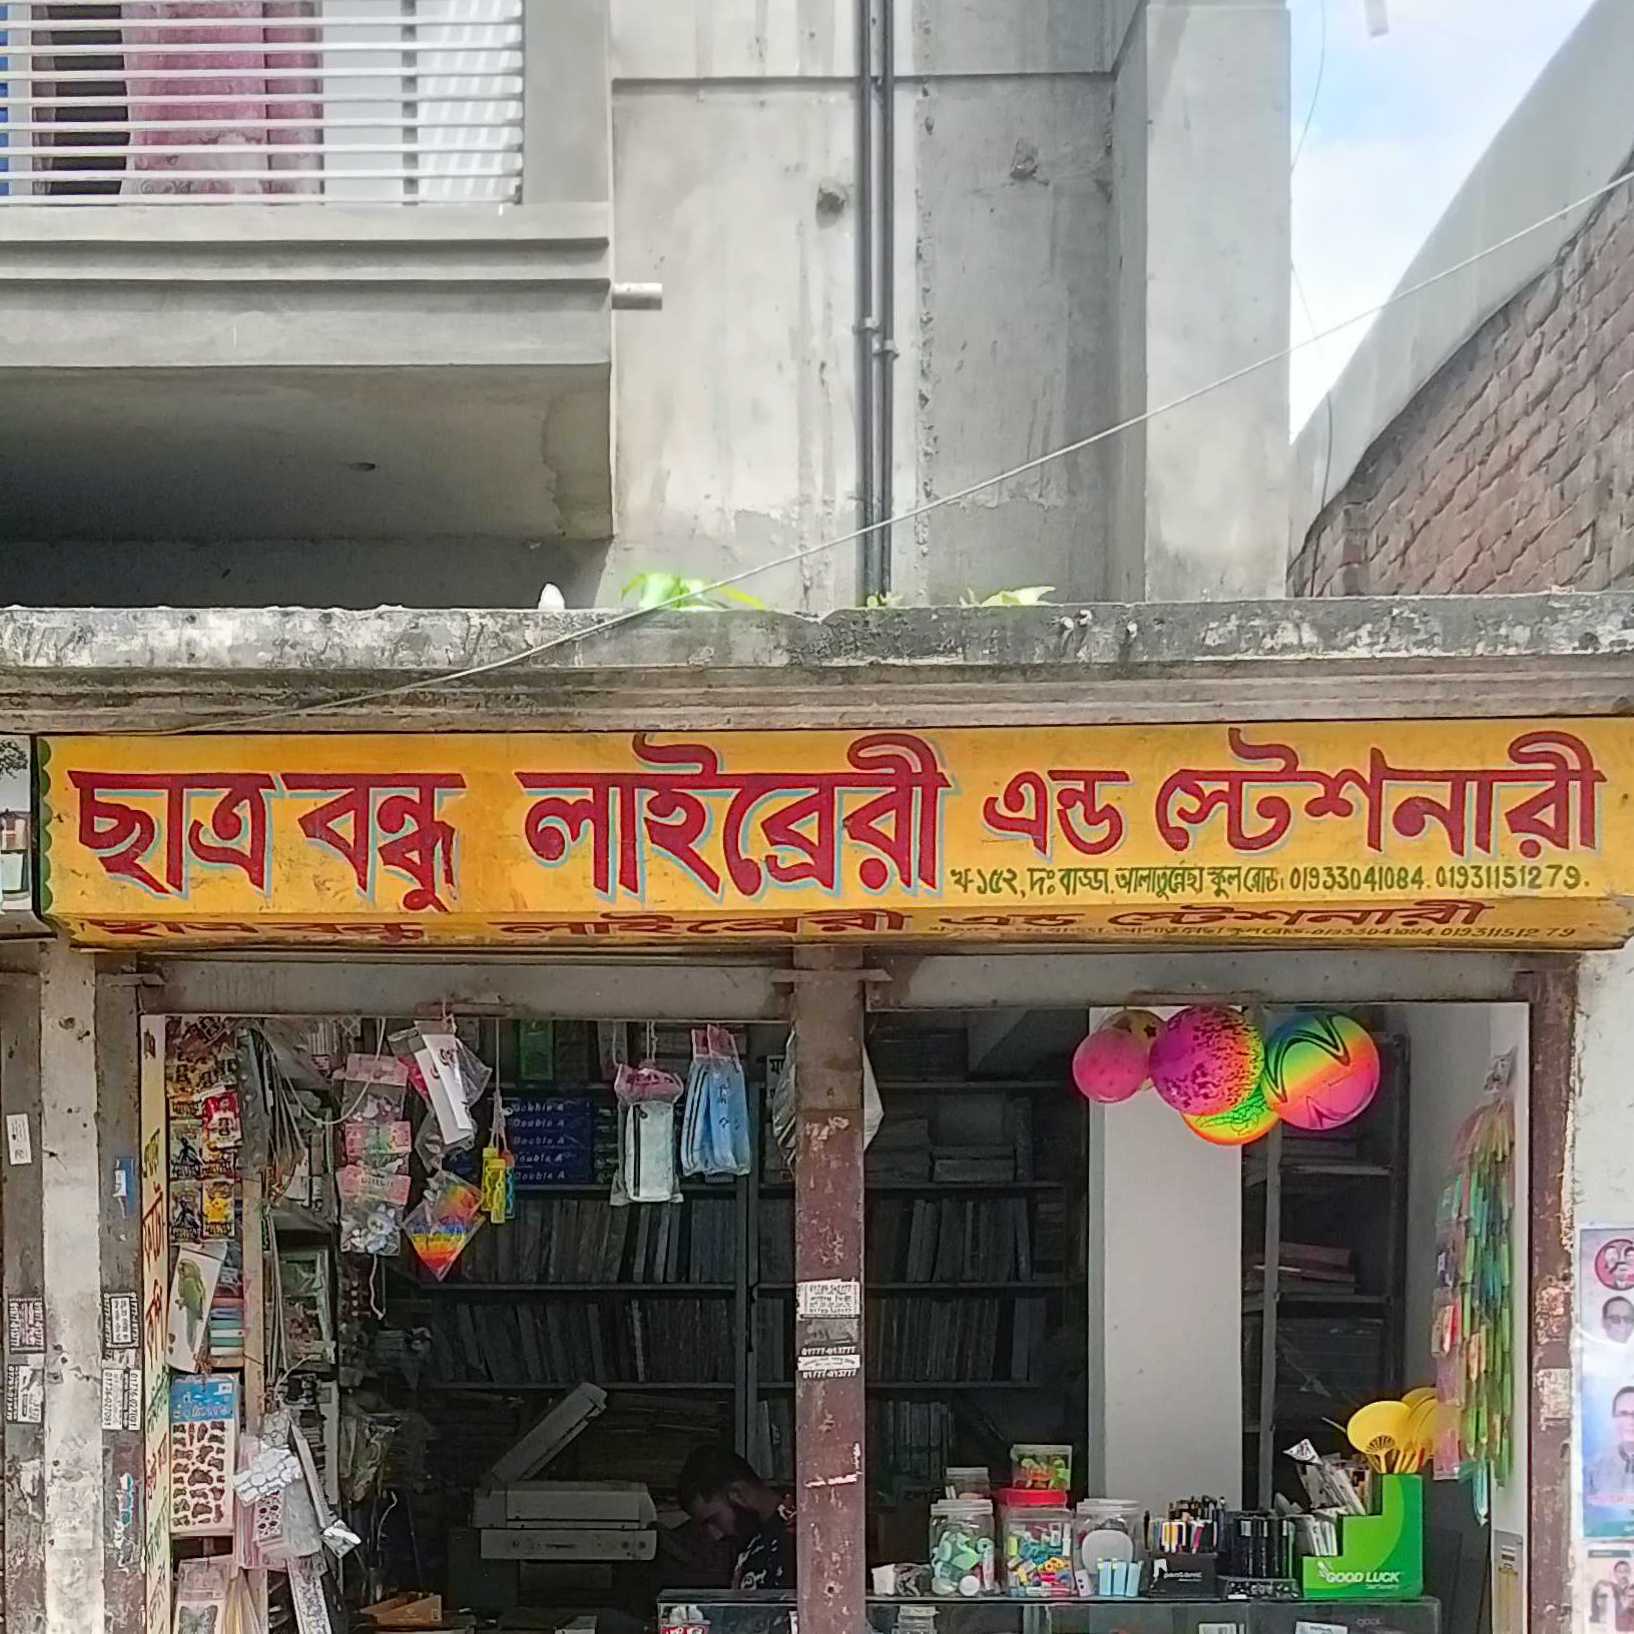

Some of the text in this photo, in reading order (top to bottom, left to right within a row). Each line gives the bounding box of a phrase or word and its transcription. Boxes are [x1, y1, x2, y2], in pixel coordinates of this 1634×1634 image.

[514, 733, 953, 899] লাইব্রেরী
[982, 769, 1132, 857] এন্ড
[1155, 727, 1608, 858] স্টেশনারী
[1326, 1571, 1401, 1583] GOOD LUCK
